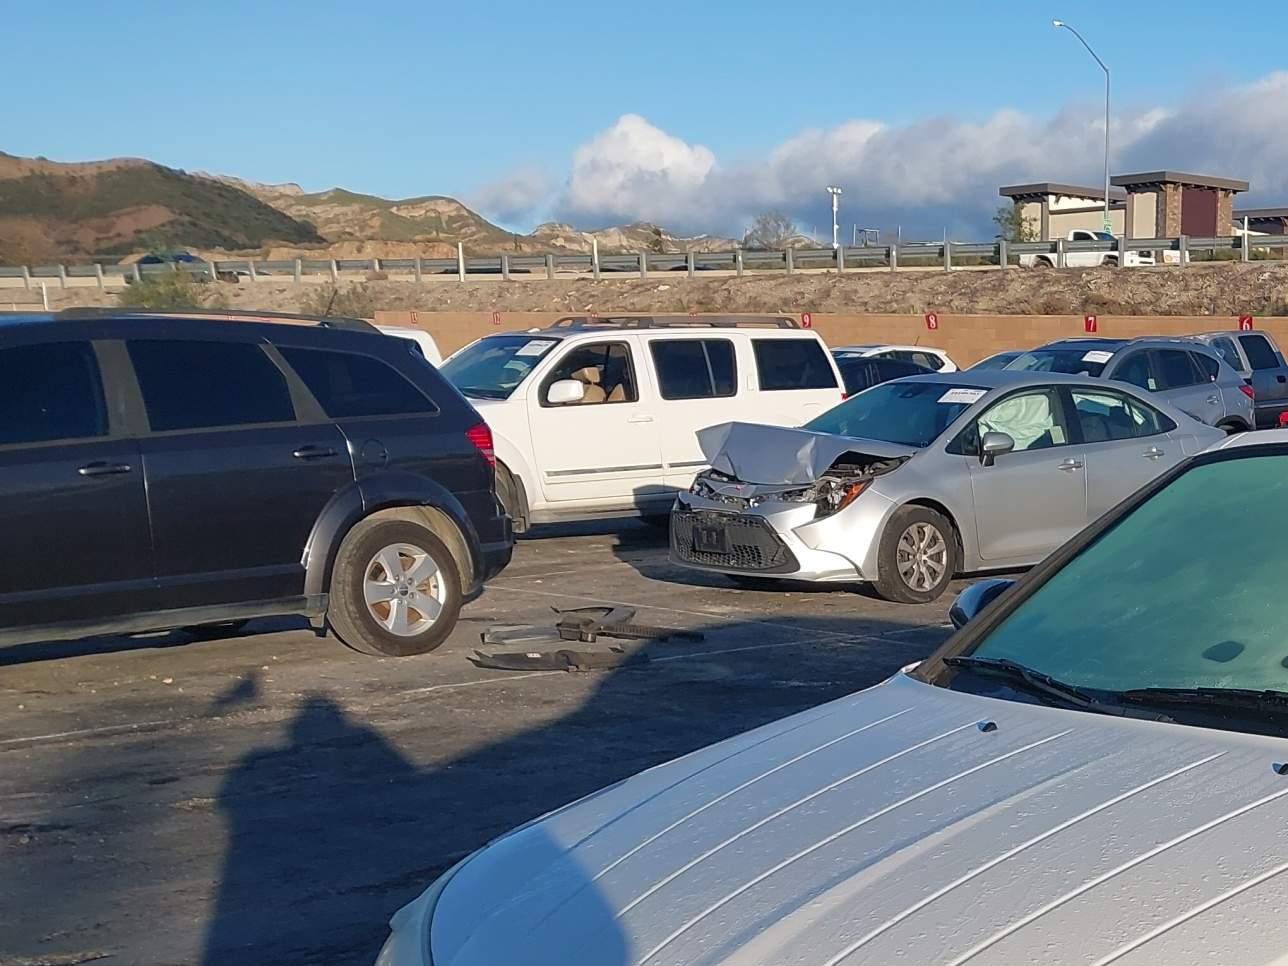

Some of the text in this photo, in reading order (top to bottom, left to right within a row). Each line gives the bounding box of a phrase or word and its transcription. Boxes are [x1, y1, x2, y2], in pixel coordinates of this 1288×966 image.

[803, 314, 810, 327] 9
[929, 315, 936, 328] 8
[1088, 317, 1095, 331] 7
[1242, 317, 1250, 330] 6
